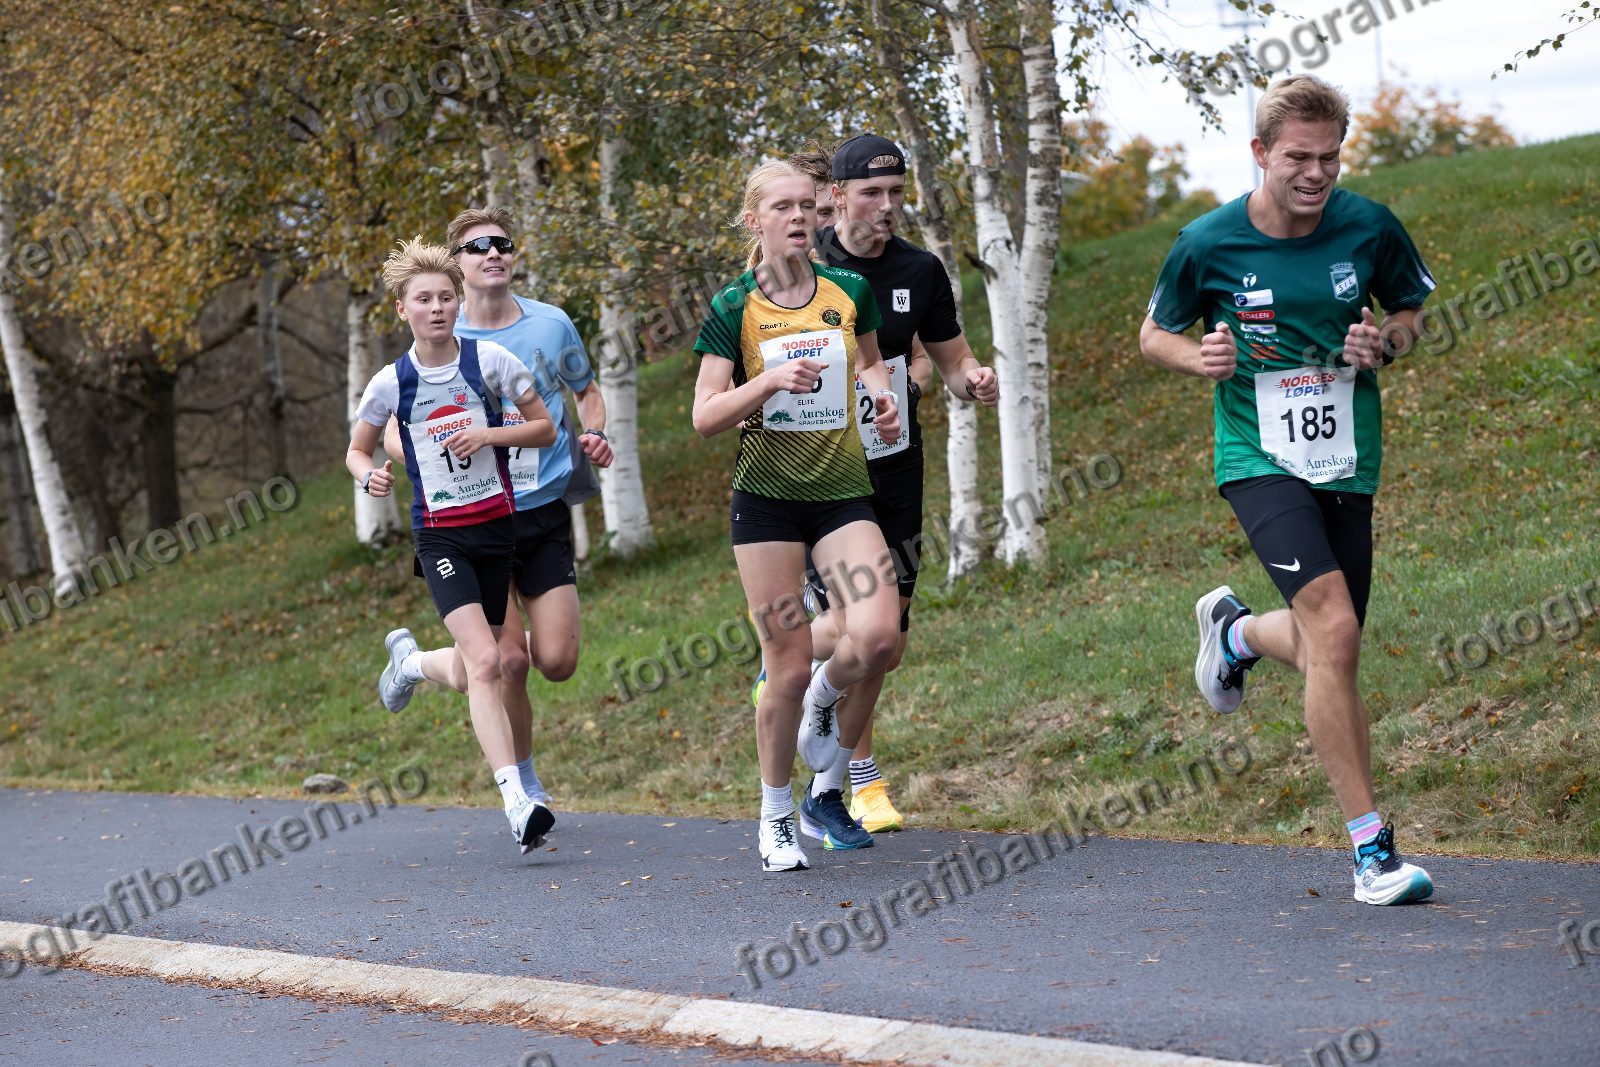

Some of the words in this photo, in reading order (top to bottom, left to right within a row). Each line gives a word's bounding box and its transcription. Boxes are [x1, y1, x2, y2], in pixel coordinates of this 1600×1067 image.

[782, 337, 830, 351] NORGES
[787, 347, 823, 360] LØPET
[1279, 373, 1337, 388] NORGES
[1285, 384, 1328, 398] LØPET
[799, 407, 845, 419] Aurskog
[427, 417, 472, 435] NORGES
[1281, 404, 1337, 443] 185
[433, 427, 467, 443] LØP
[1306, 454, 1354, 471] Aurskog
[510, 471, 535, 481] rskog
[1307, 467, 1347, 478] SPAREBANK
[458, 476, 497, 494] Aurskog
